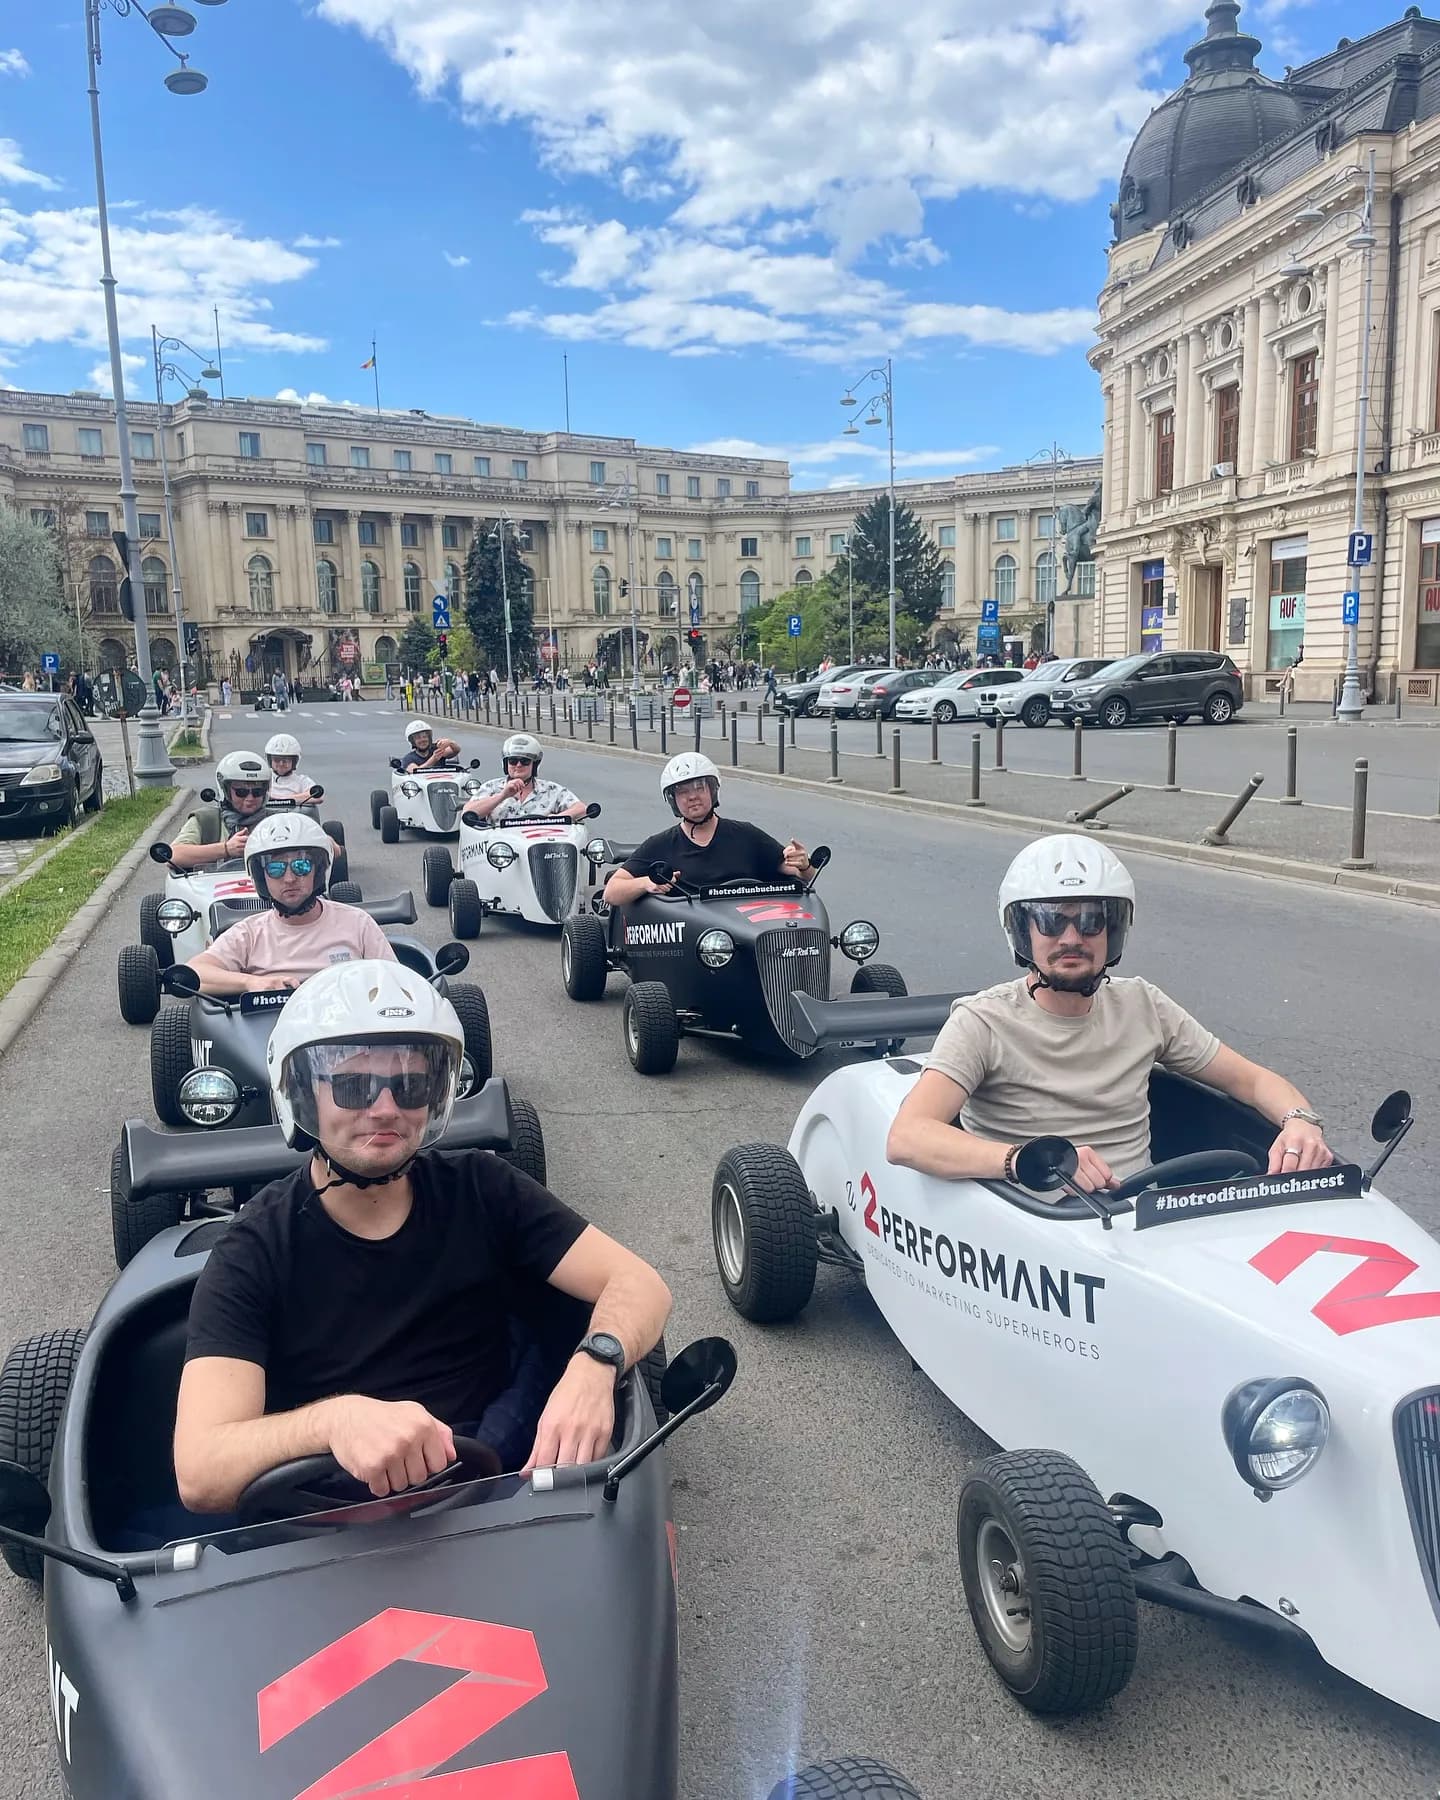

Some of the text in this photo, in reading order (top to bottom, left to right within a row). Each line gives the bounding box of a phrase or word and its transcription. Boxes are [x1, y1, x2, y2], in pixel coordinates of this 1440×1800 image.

[1353, 536, 1367, 562] P
[986, 603, 995, 617] P
[1280, 597, 1297, 619] AUF
[1346, 596, 1355, 615] P
[45, 656, 55, 669] P
[708, 884, 796, 896] #hotrodfunbucharest
[1156, 1172, 1345, 1211] #hotrodfunbucharest
[904, 1270, 916, 1287] TO
[917, 1279, 981, 1319] MARKETING
[986, 1310, 1101, 1361] SUPERHEROES
